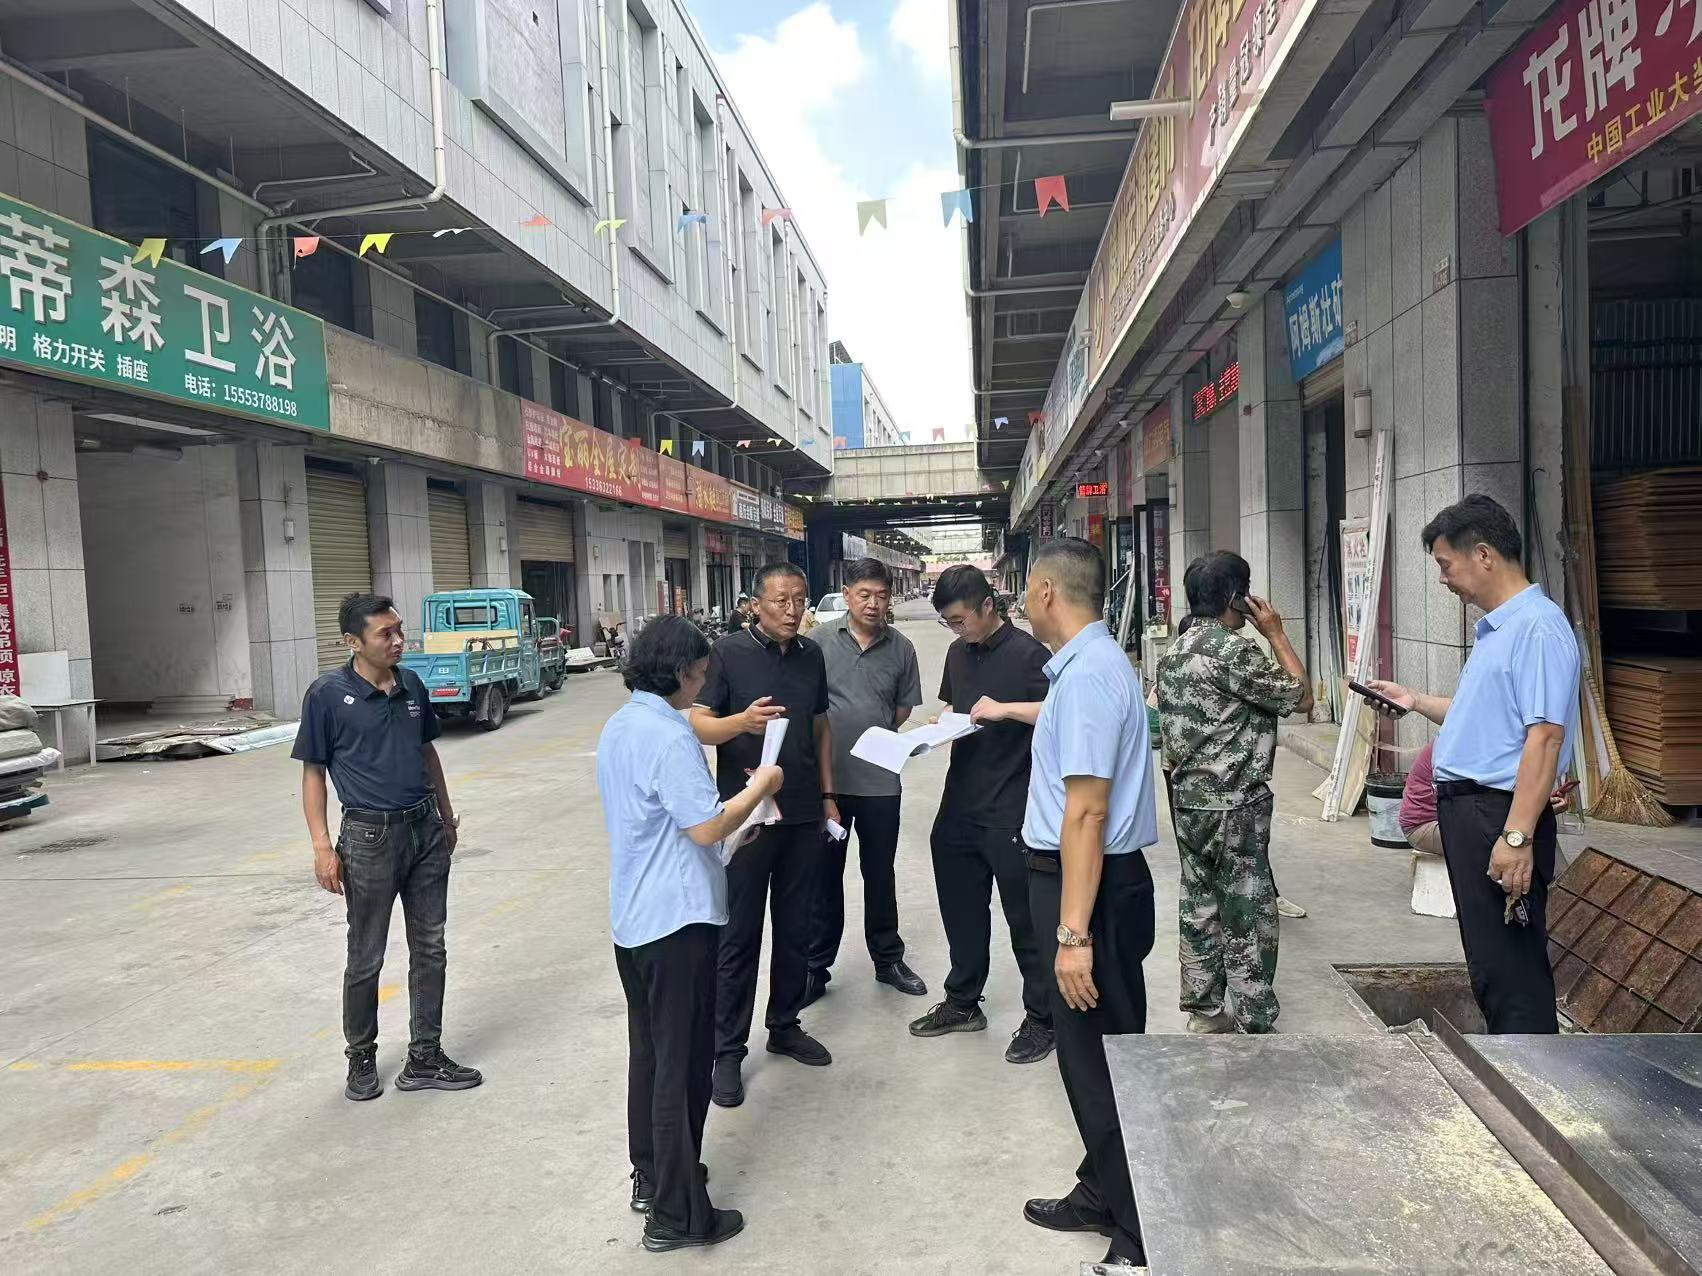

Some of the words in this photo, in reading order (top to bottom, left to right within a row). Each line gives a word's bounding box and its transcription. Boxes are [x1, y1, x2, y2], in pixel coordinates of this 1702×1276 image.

[33, 334, 107, 374] 格力开关
[116, 354, 149, 383] 插座
[223, 384, 298, 417] 15553788198
